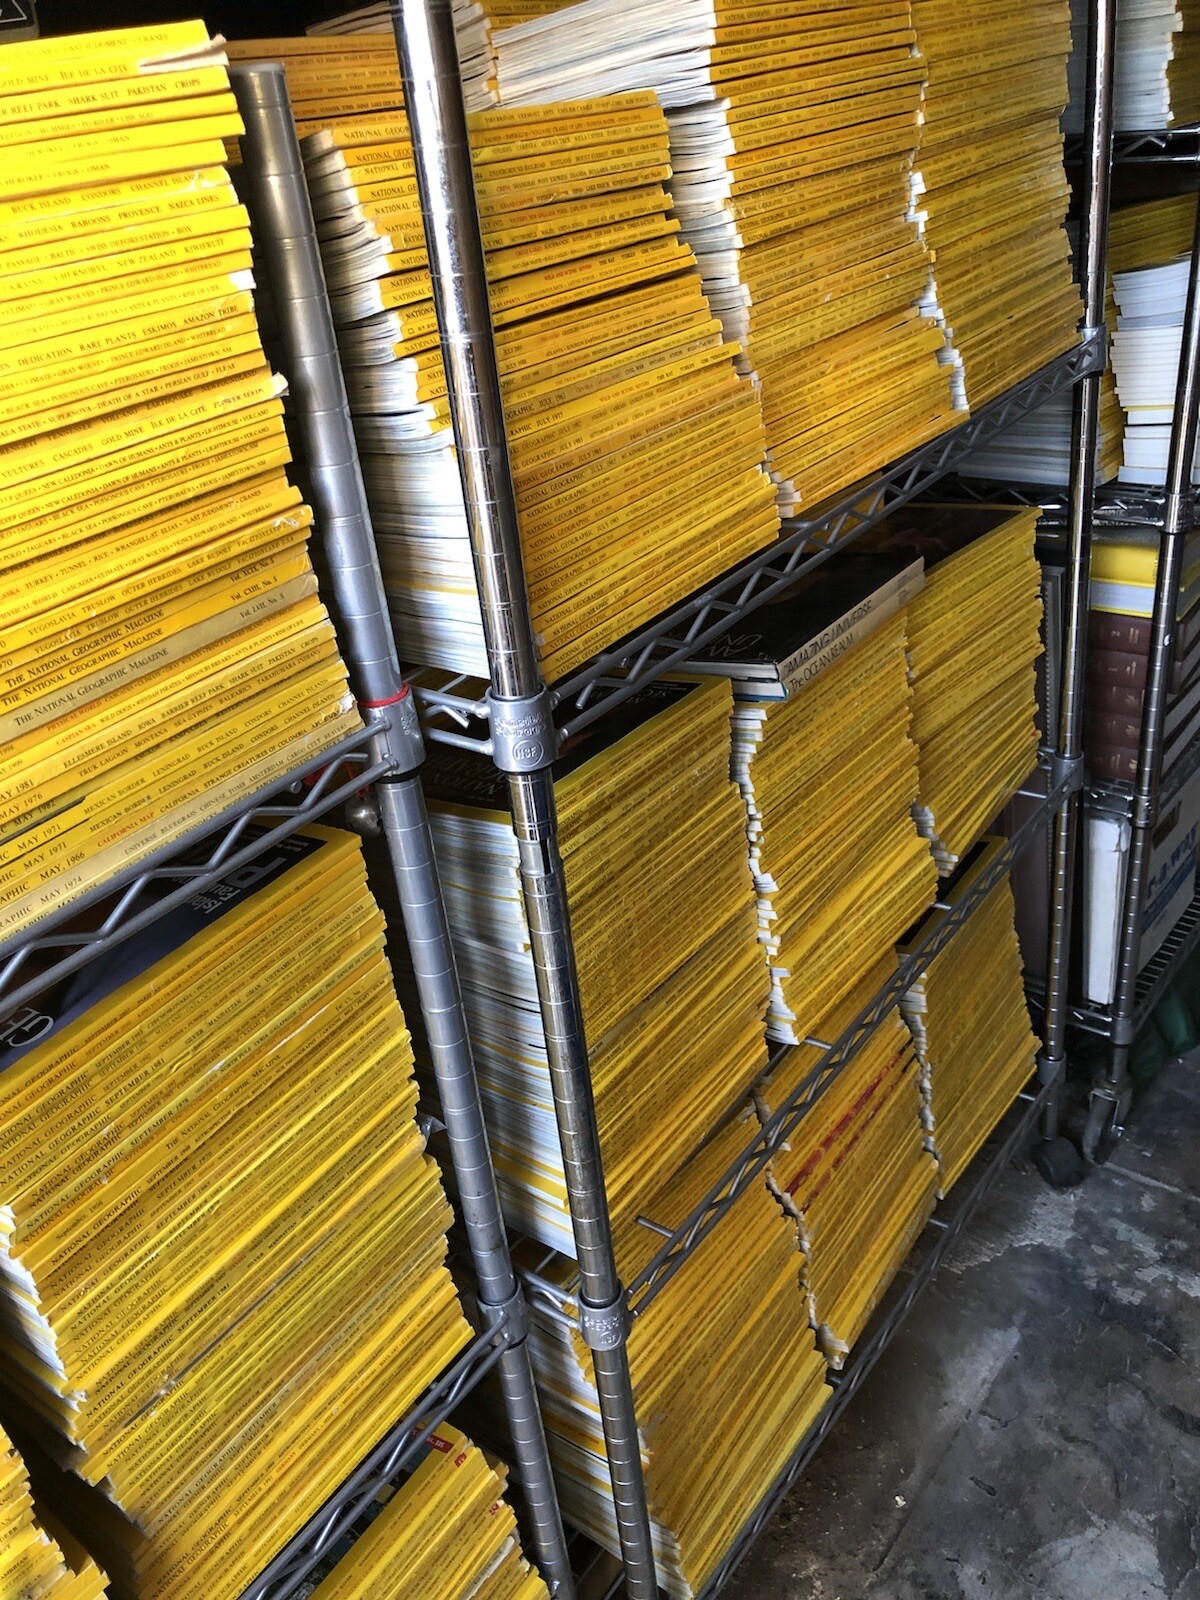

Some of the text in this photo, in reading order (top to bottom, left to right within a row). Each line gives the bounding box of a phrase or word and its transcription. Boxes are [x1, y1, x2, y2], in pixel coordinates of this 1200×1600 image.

[38, 101, 60, 111] PARK
[69, 95, 97, 106] SHARK
[127, 84, 167, 96] PAKISTAN
[175, 79, 200, 90] CROPS
[344, 129, 381, 139] NATIONAL
[356, 151, 392, 162] NATIONAL
[12, 188, 121, 213] BUCK ISLAND CONDORS
[371, 185, 404, 198] NATIONAL
[375, 203, 410, 214] NATIONAL
[18, 195, 220, 237] RHODESIA BABOONS PROVENCE NAZCA LINES
[386, 221, 421, 233] NATIONAL
[139, 238, 224, 264] ZEALAND KIWIFRUIT
[390, 274, 423, 287] NATIONAL
[18, 305, 238, 366] DEDICATION RARE PLANTS ESKIMOS AMAZON TRIBE
[405, 338, 436, 352] NATIONAL
[143, 363, 235, 397] STAR PERSIAN GULF FLEAS
[537, 417, 550, 427] JULY
[2, 460, 45, 478] VULTURES
[53, 444, 93, 461] CASCADES
[101, 434, 122, 446] GOLD
[125, 427, 144, 438] MINE
[179, 412, 188, 420] LA
[59, 408, 269, 485] CALEDONIA LIGHTHOUSE VOLCANO
[520, 472, 585, 504] NATIONAL GEOGRAPHIC
[527, 487, 588, 519] NATIONAL GEOGRAPHIC
[62, 479, 218, 540] BLACK SEA CAVE PTEROSAURS FROGS
[526, 502, 587, 535] NATIONAL GEOGRAPHIC
[530, 515, 590, 549] NATIONAL GEOGRAPHIC
[533, 547, 559, 563] NATIONAL
[561, 530, 593, 550] GEOGRAPHIC
[25, 523, 178, 589] TURKEY TUNNEL RICE ELIAS
[28, 547, 232, 636] YUGOSLAVIA TRUSLOW OUTER HEBRIDES LAKE RUDOLF
[2, 627, 163, 706] THE NATIONAL GEOGRAPHIC MAGAZINE
[6, 609, 164, 687] THE NATIONAL GEOGRAPHIC MAGAZINE
[14, 648, 168, 726] THE NATIONAL GEOGRAPHIC MAGAZINE
[16, 636, 318, 792] 1981 ELLESMERE ISLAND PAKISTAN CROPS
[24, 793, 43, 806] 1976
[79, 763, 98, 777] TRUK
[100, 748, 128, 767] LAGOON
[135, 729, 168, 748] MONTANA
[18, 754, 190, 852] MAY 1971 MEXICAN BORDER LENINGRAD
[67, 852, 85, 866] 1966
[98, 821, 138, 847] CALIFORNIA
[140, 812, 155, 824] MAP
[160, 788, 199, 812] CALIFORNIA
[24, 842, 67, 870] MAY 1971
[41, 811, 196, 904] MAY 1974 UNIVERSE BLUEGRASS
[1, 1151, 46, 1186] NATIONAL
[49, 1107, 101, 1148] GEOGRAPHIC
[105, 1071, 149, 1106] SEPTEMBER
[45, 1095, 97, 1137] GEOGRAPHIC
[17, 1113, 112, 1188] NATIONAL GEOGRAPHIC
[27, 1111, 173, 1228] NATIONAL GEOGRAPHIC SEPTEMBER
[52, 1187, 142, 1264] NATIONAL GEOGRAPHIC
[87, 1295, 217, 1417] NATIONAL GEOGRAPHIC SEPTEMBER
